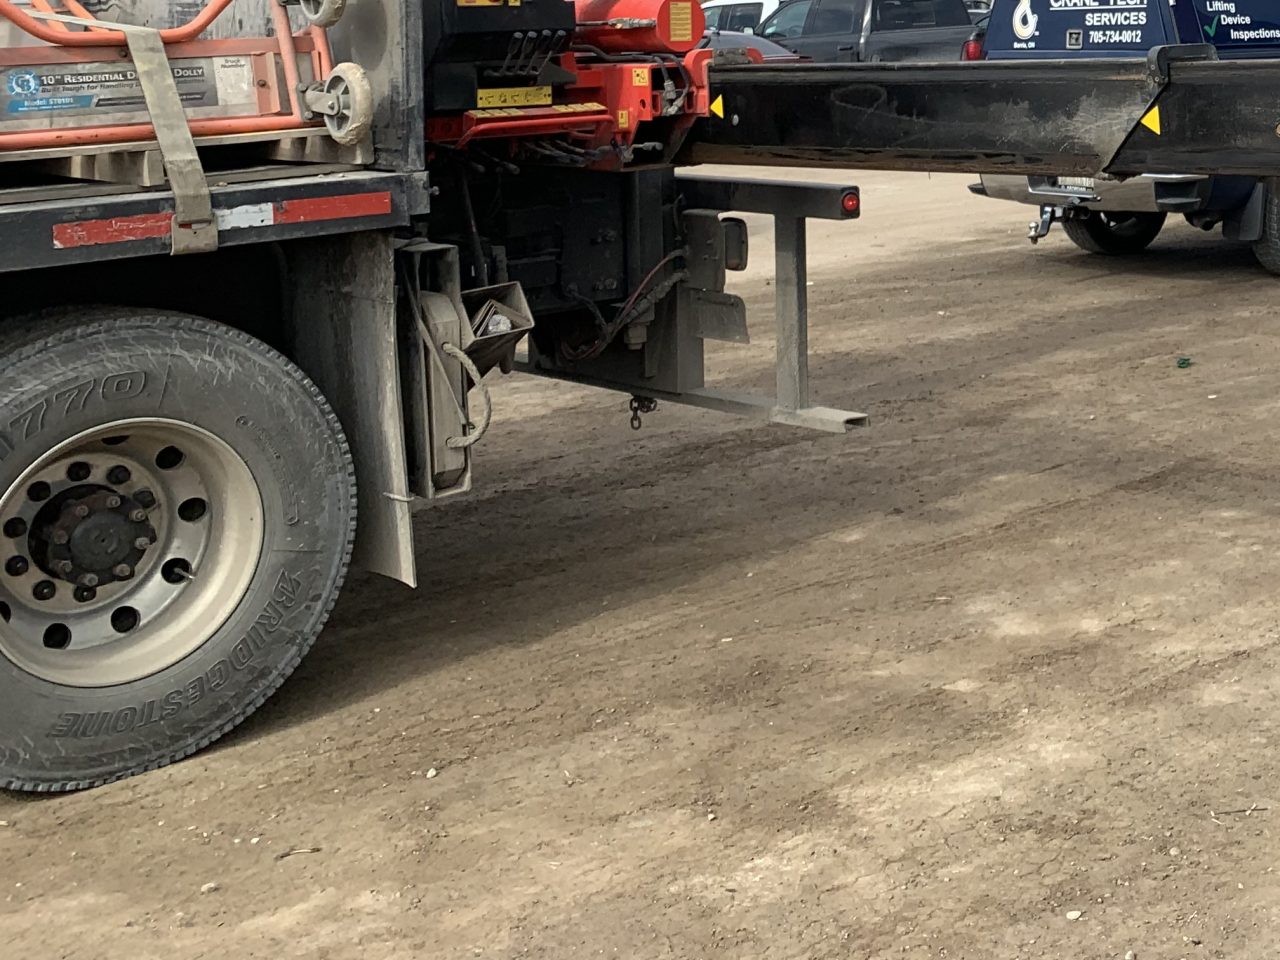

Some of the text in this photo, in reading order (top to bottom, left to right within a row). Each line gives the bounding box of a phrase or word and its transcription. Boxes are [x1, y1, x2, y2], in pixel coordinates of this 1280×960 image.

[1206, 1, 1236, 14] Lifting
[1085, 11, 1147, 27] SERVICES
[1220, 14, 1251, 26] Device
[1089, 30, 1141, 44] 705-734-0012
[1230, 28, 1280, 42] Inspections
[64, 72, 123, 83] RESIDENTIAL
[174, 68, 203, 77] DOLLY
[48, 568, 302, 738] BRIDGESTONE
